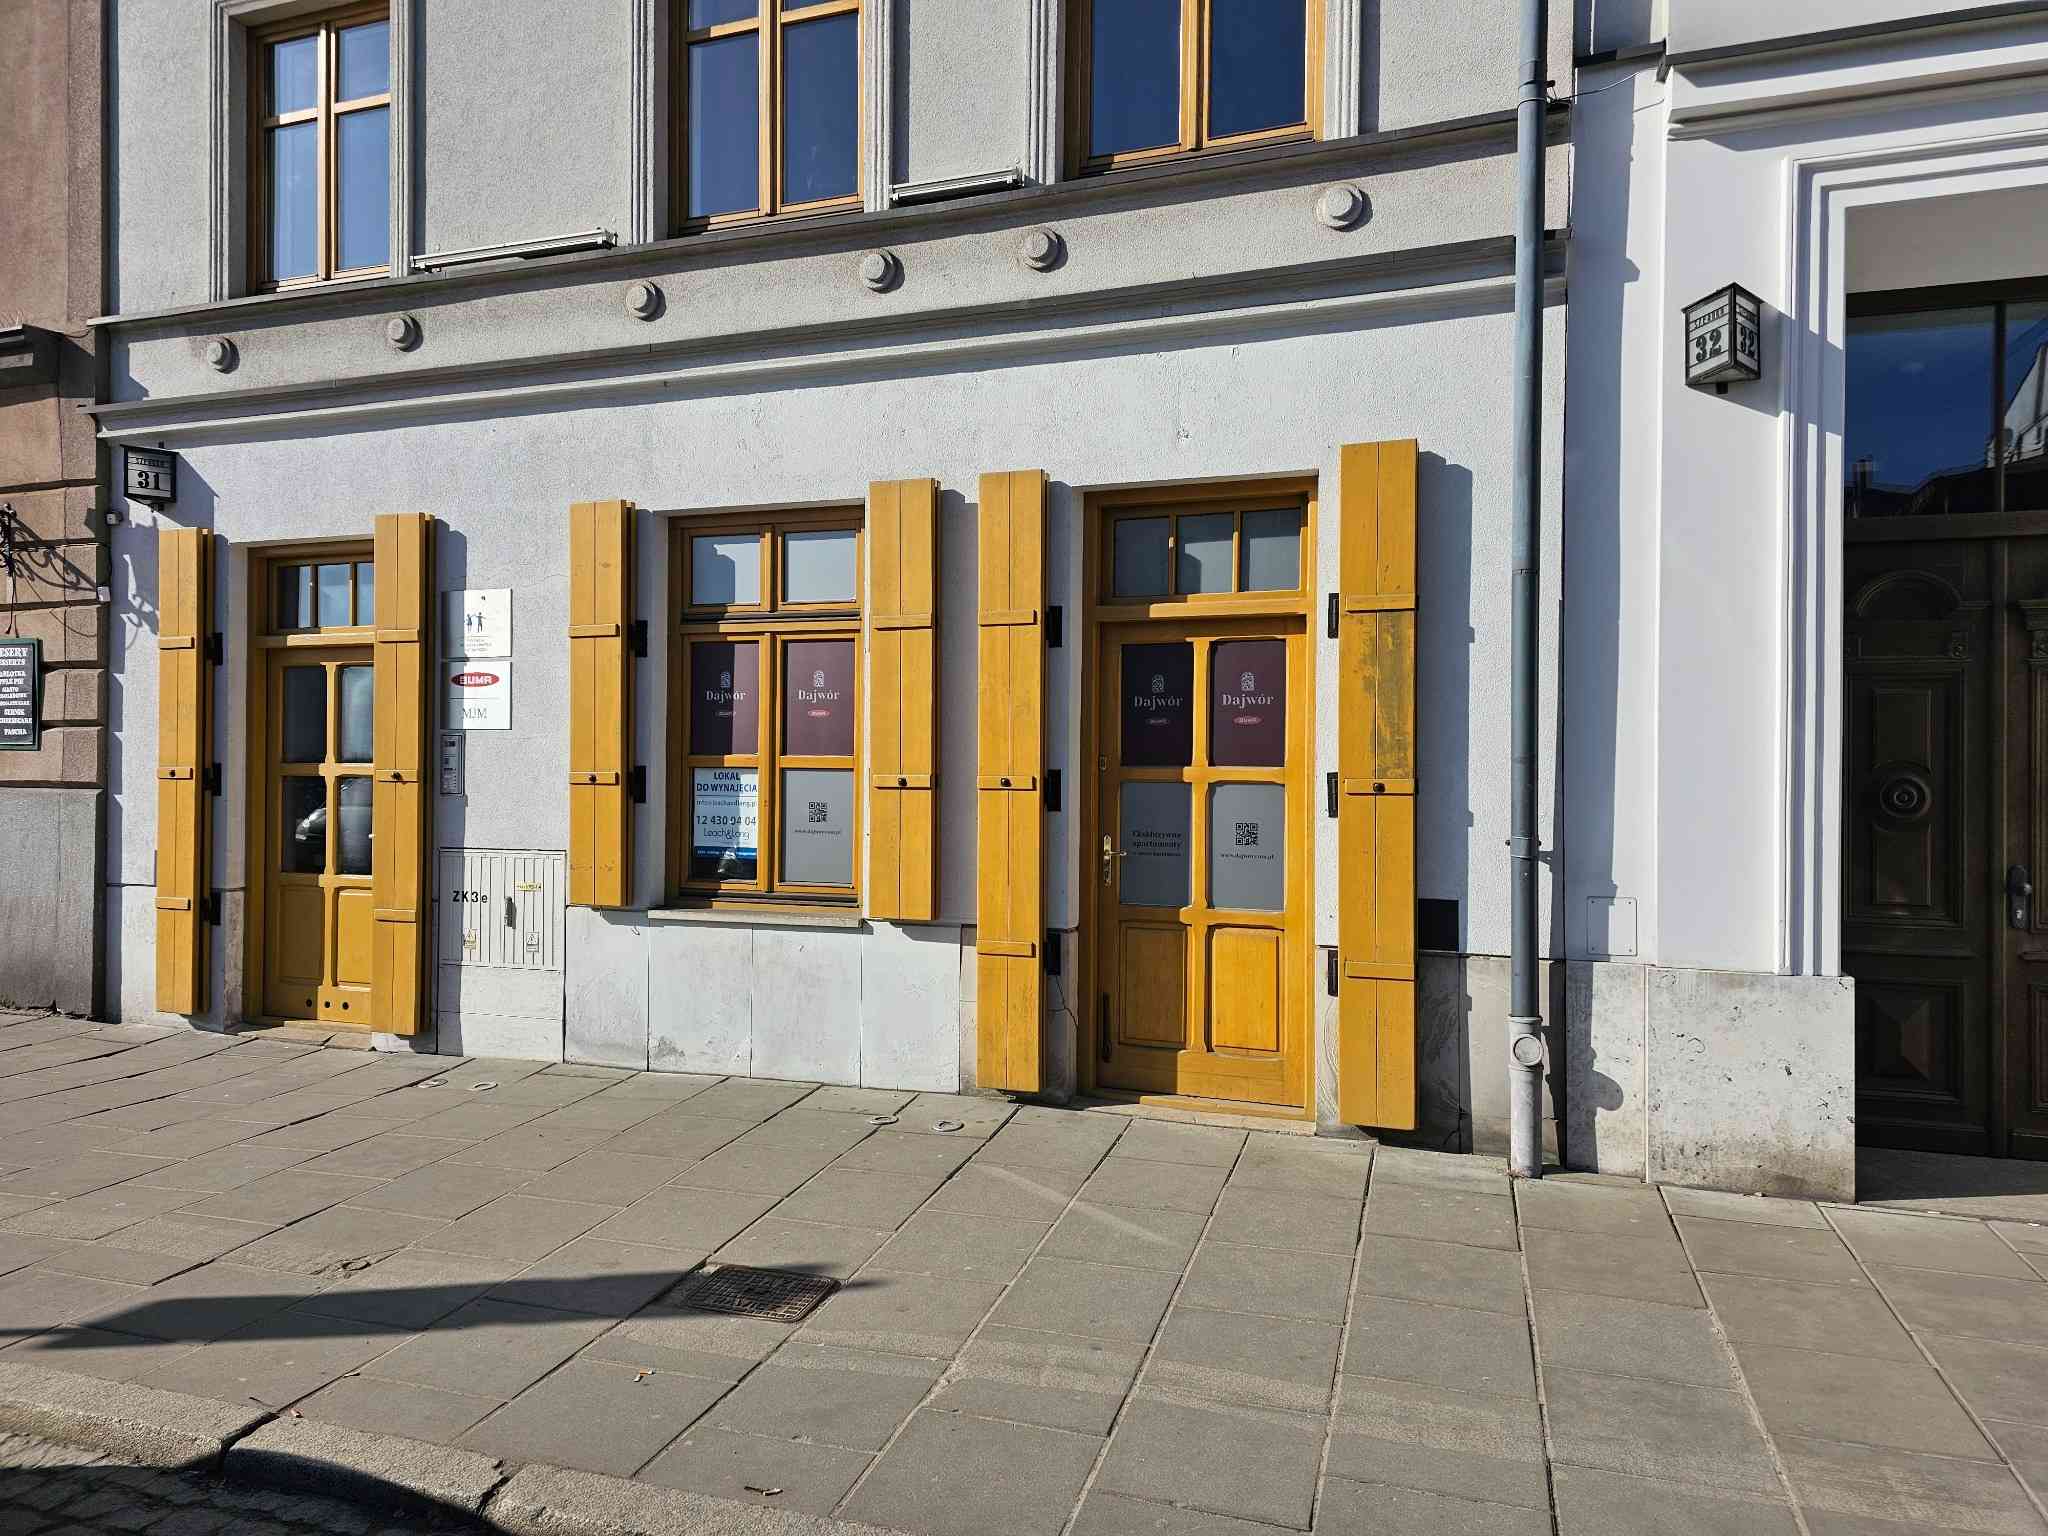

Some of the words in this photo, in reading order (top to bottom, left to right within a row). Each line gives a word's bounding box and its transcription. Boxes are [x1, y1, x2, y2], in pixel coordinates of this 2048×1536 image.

[1695, 328, 1721, 362] 32
[1740, 325, 1757, 358] 32
[137, 470, 160, 490] 31
[705, 688, 748, 704] Dajwór
[797, 688, 841, 703] Dajwór
[1135, 694, 1184, 711] Dajwór
[1222, 693, 1275, 709] Dajwór
[713, 771, 741, 781] LOKAL
[696, 783, 709, 792] DO
[696, 815, 708, 825] 12
[710, 815, 728, 825] 430
[744, 816, 757, 826] 04
